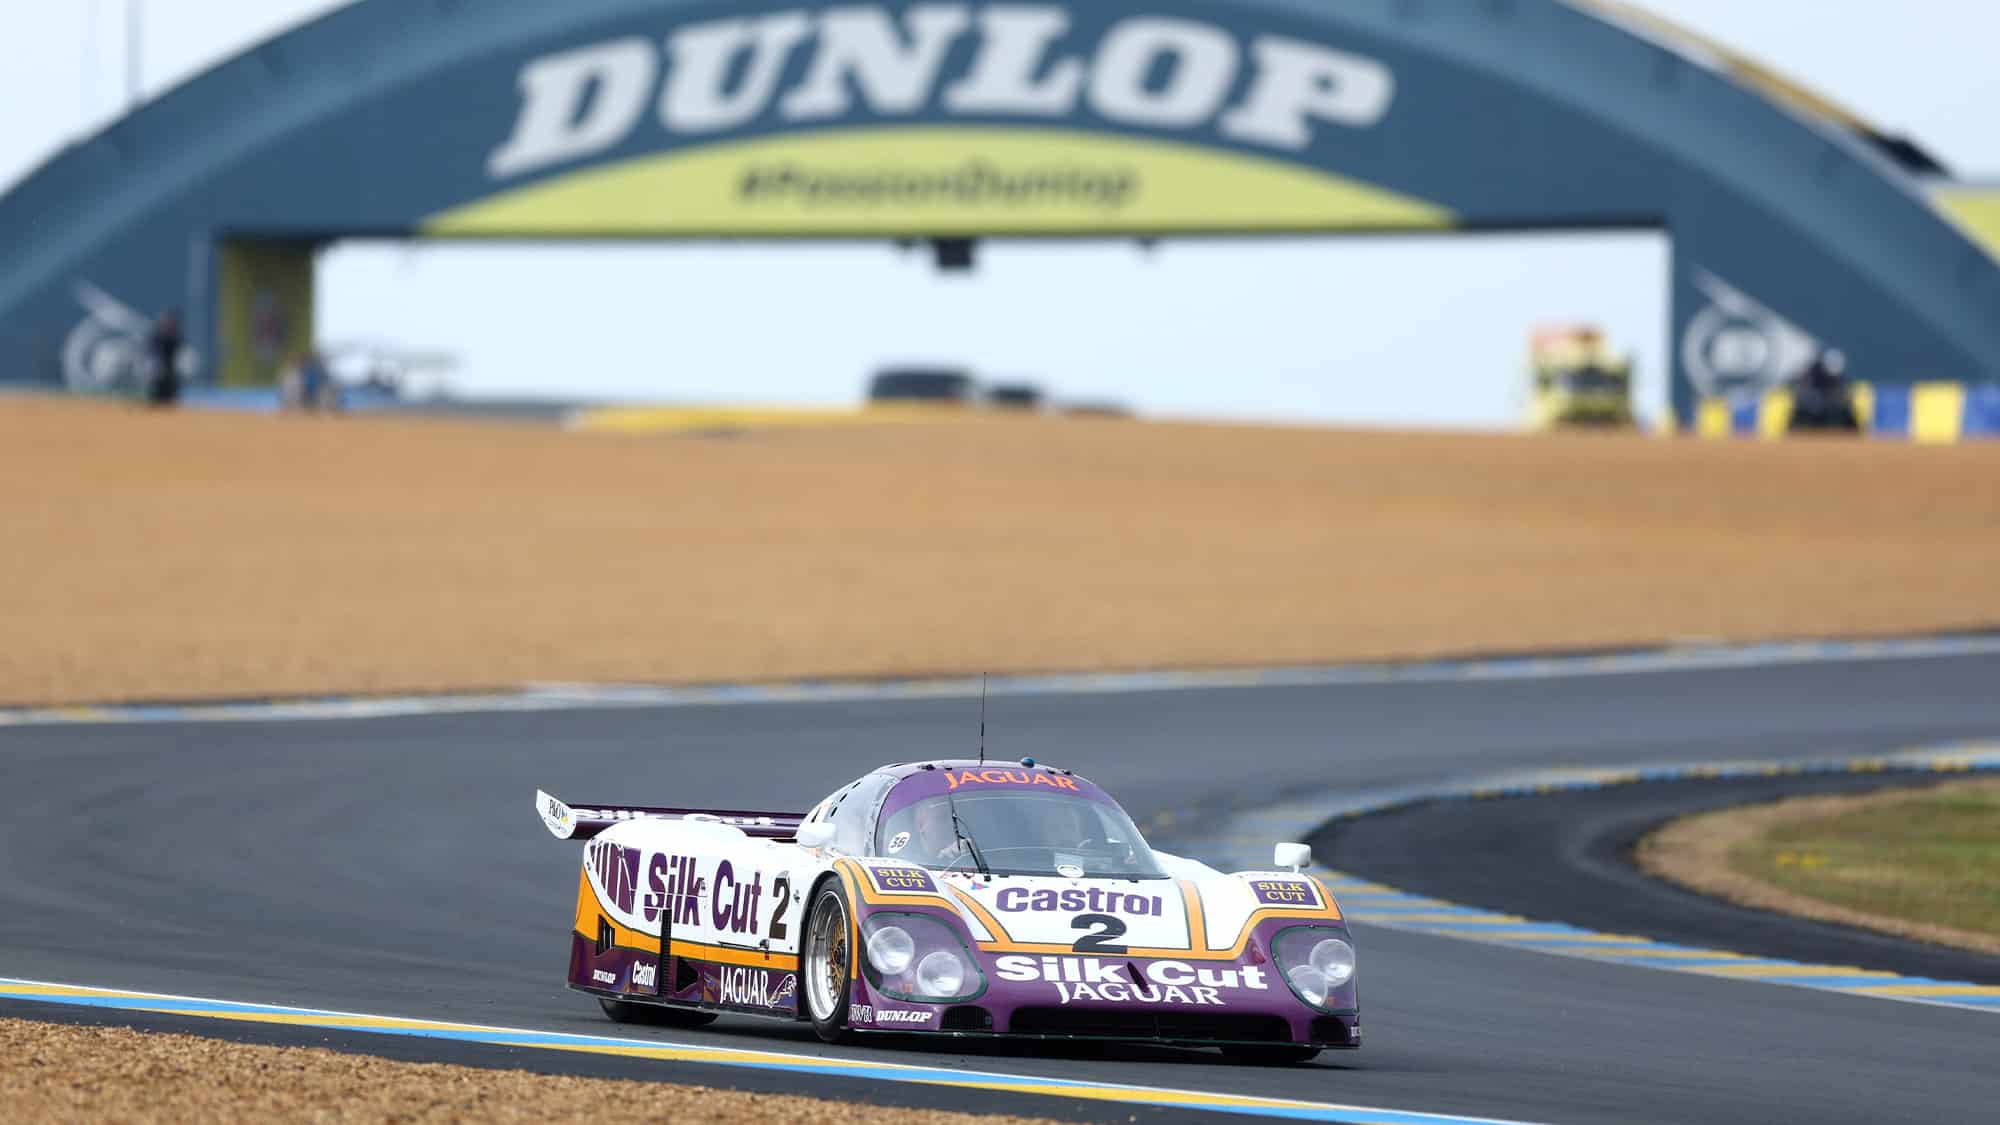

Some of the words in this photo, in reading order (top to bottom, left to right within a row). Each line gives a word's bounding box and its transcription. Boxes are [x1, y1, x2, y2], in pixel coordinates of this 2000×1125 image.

[486, 4, 1394, 178] DUNLOP
[944, 770, 1079, 791] JAGUAR
[877, 868, 925, 879] SILK
[885, 877, 926, 888] CUT
[643, 852, 702, 927] Silk
[712, 859, 762, 935] Cut
[769, 870, 791, 940] 2
[1257, 881, 1305, 891] SILK
[1265, 891, 1305, 902] CUT
[996, 887, 1162, 917] Castrol
[1070, 913, 1128, 954] 2
[995, 955, 1129, 983] Silk
[1146, 960, 1269, 990] Cut
[720, 966, 769, 1006] JAGUAR
[1052, 981, 1226, 1005] JAGUAR
[875, 1009, 932, 1023] DUNLOP
